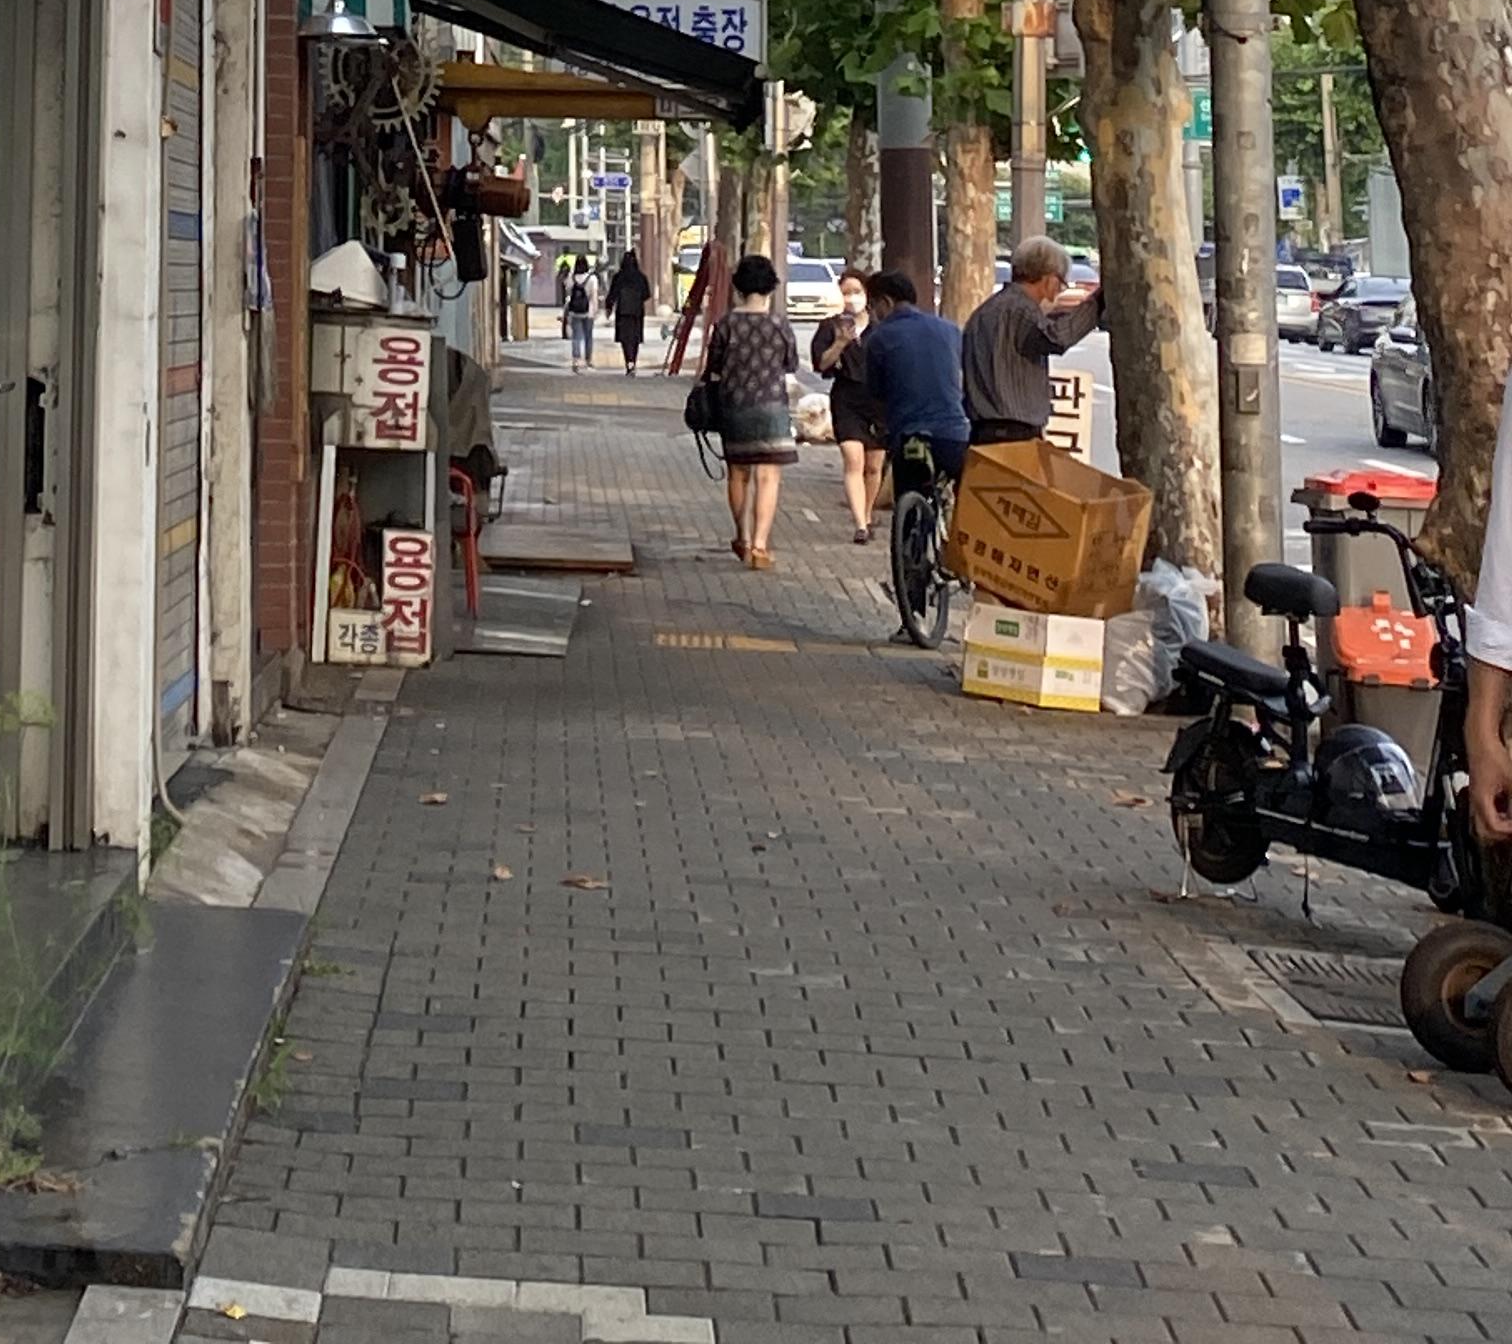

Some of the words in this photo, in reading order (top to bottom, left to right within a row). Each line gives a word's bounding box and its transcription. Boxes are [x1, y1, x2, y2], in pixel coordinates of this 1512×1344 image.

[369, 336, 425, 442] 용접
[338, 623, 379, 654] 각종
[380, 536, 433, 655] 용접
